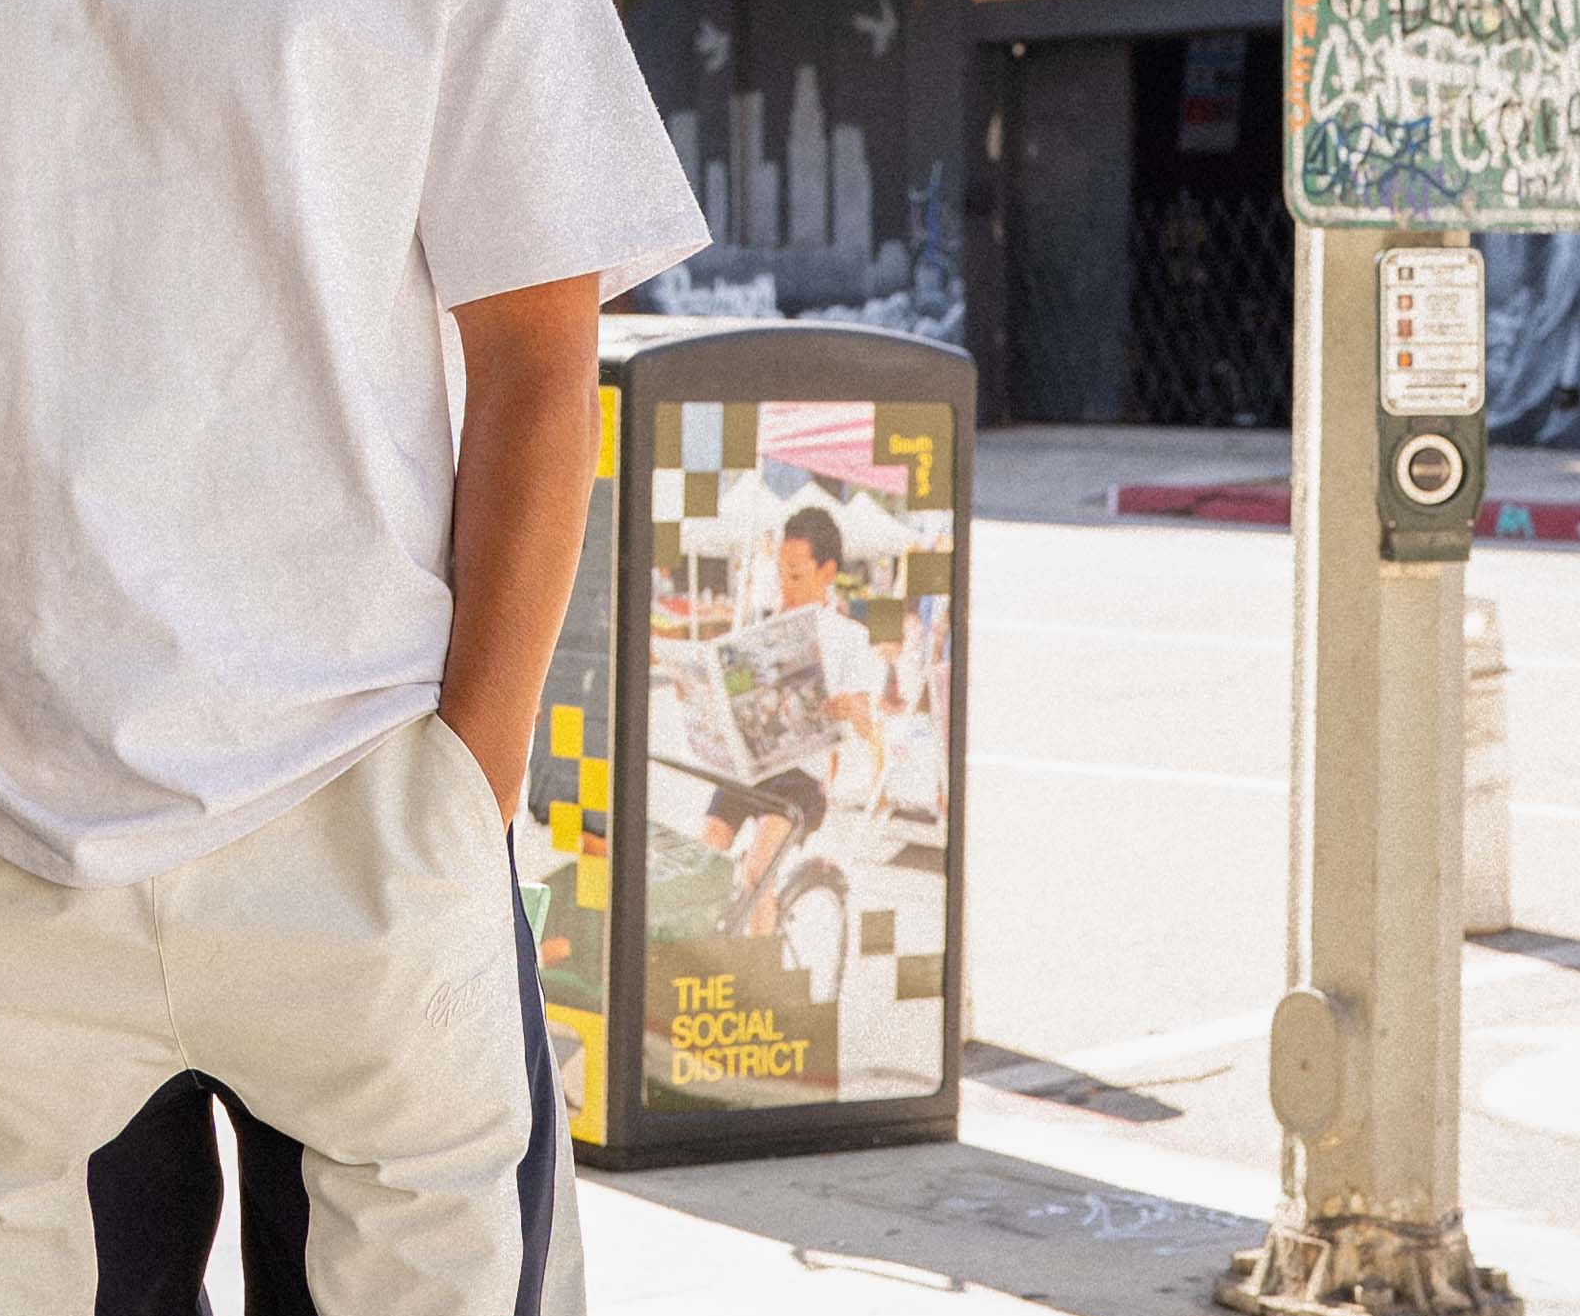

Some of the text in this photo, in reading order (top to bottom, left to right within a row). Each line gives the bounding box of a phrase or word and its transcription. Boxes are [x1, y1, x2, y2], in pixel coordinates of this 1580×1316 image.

[672, 974, 736, 1013] THE
[671, 1008, 785, 1050] SOCIAL
[671, 1039, 811, 1085] DISTRICT
